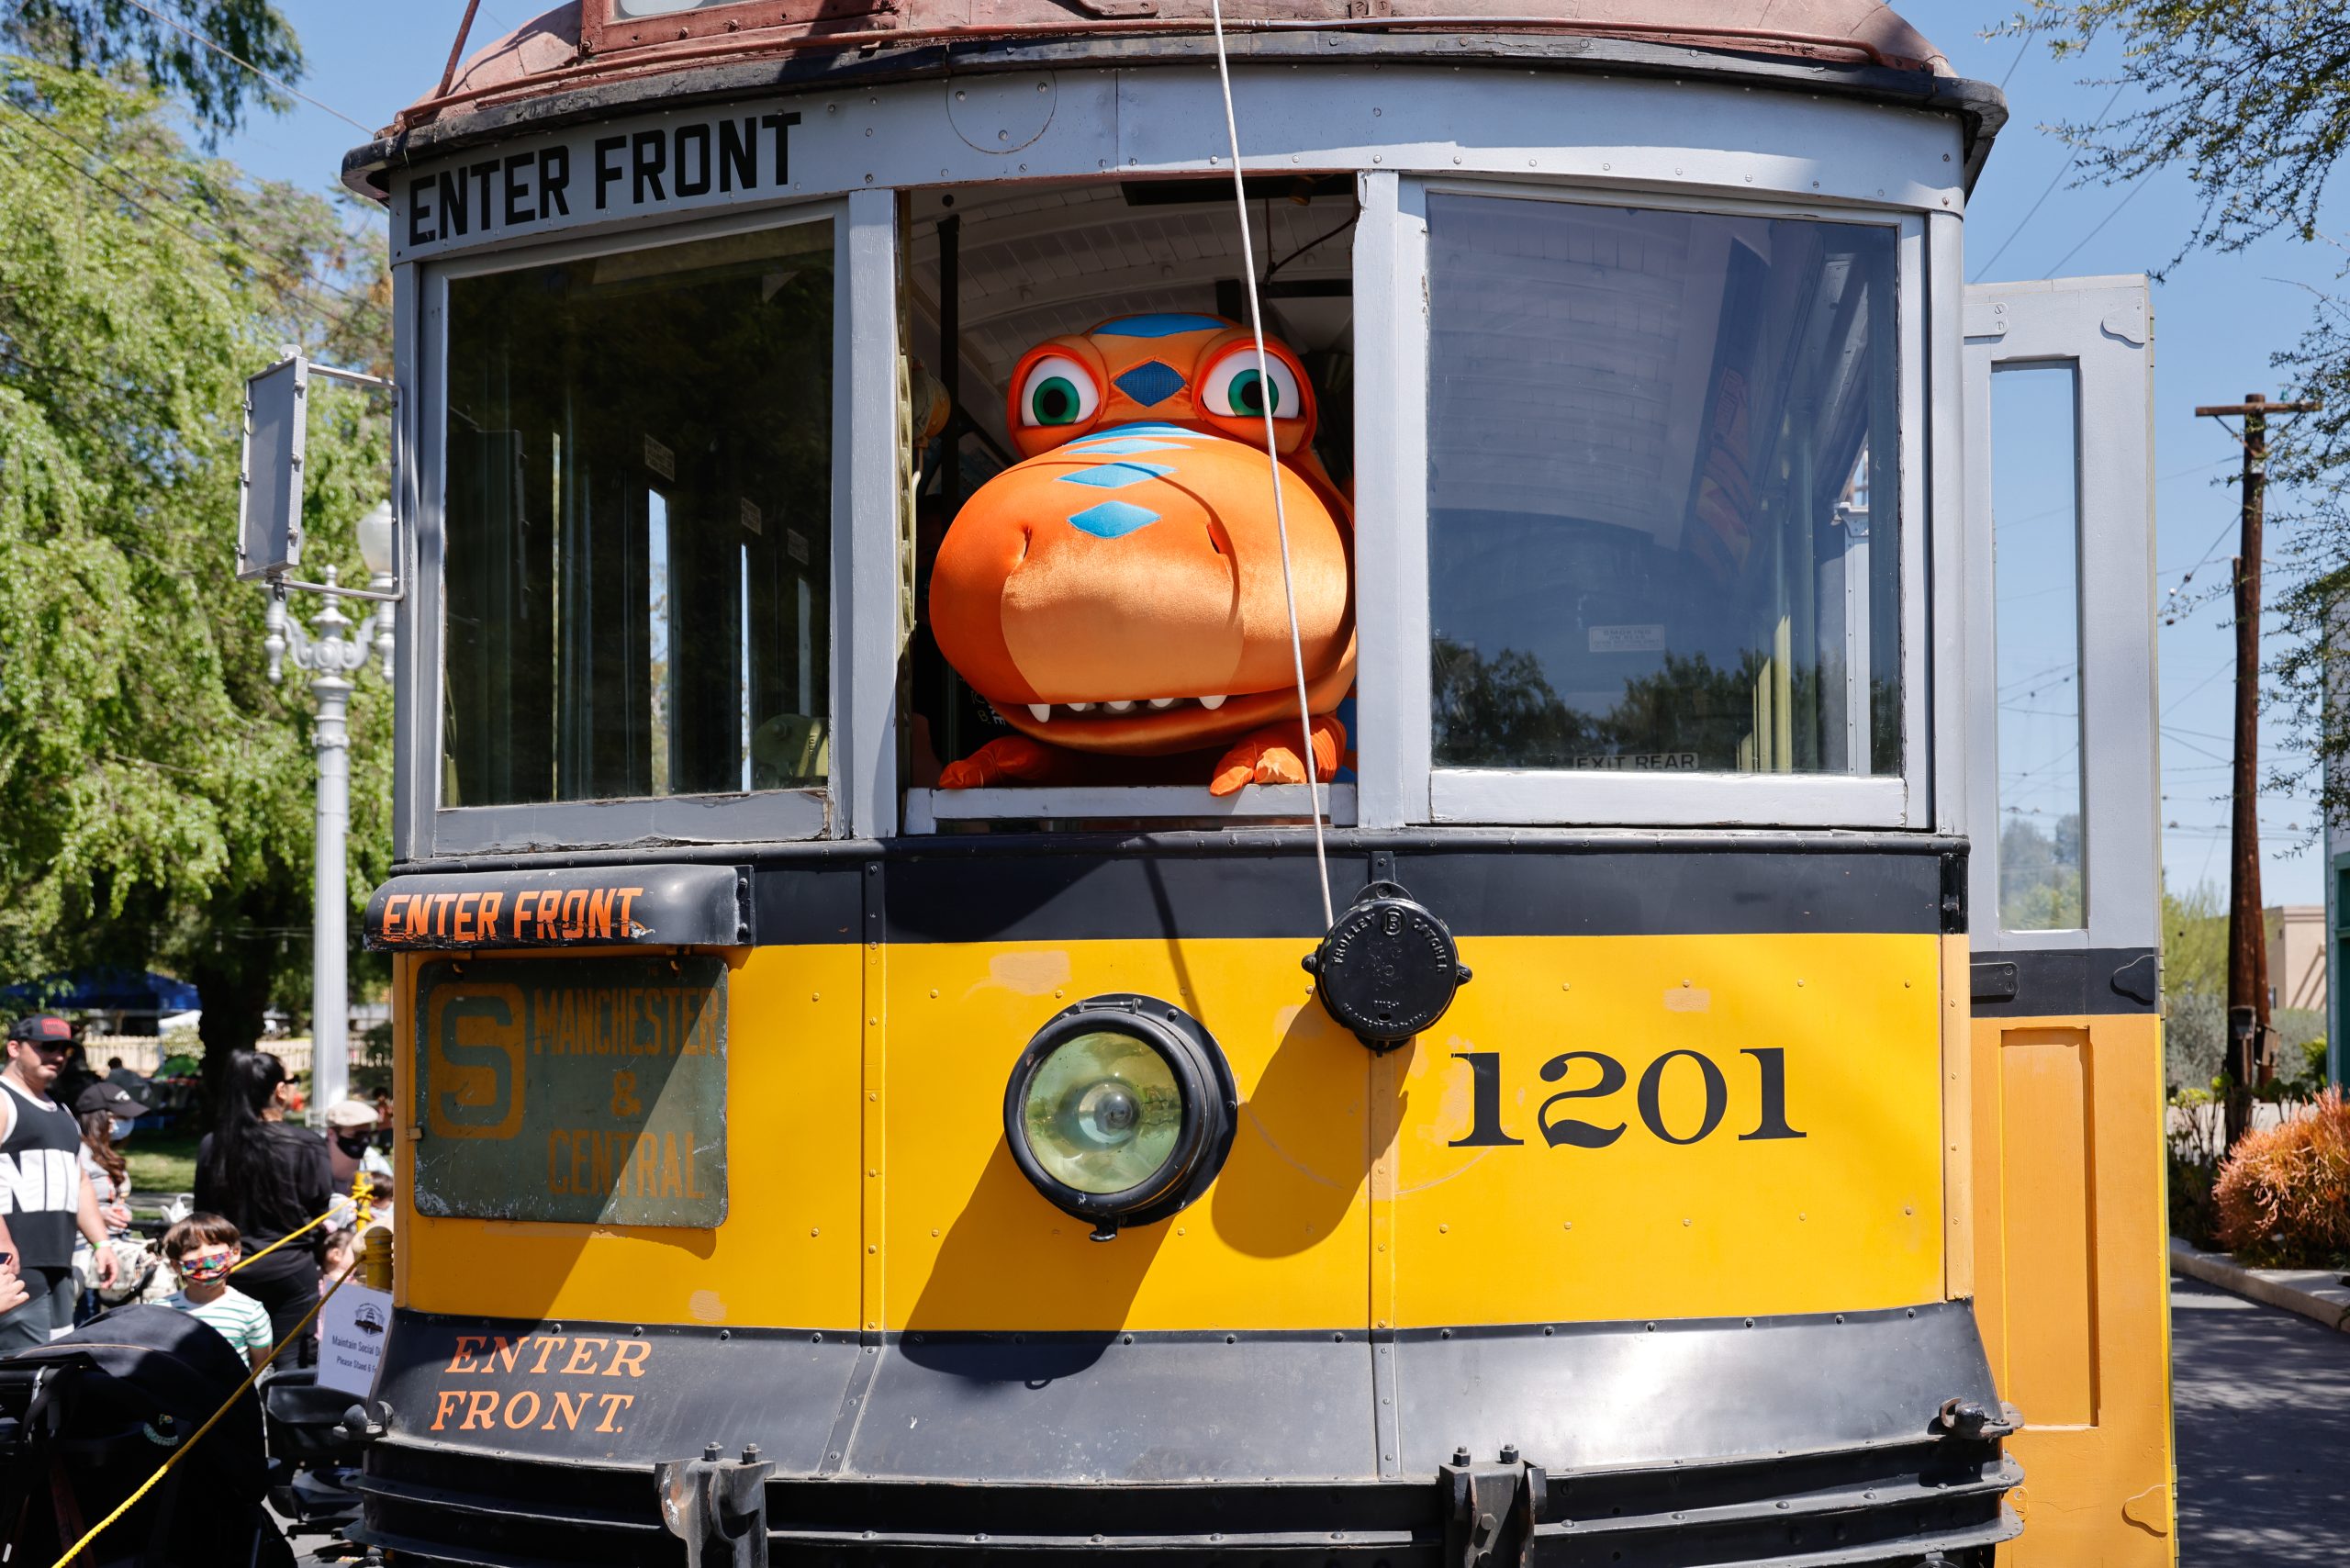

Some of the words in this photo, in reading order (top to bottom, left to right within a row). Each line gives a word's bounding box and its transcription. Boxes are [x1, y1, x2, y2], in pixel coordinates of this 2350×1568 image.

[409, 145, 569, 246] ENTER
[595, 112, 801, 209] FRONT
[1577, 756, 1626, 769] EXIT
[1635, 754, 1695, 769] REAR
[383, 890, 503, 942] ENTER
[513, 888, 643, 939] FRONT
[534, 987, 718, 1057] MANCHESTER
[430, 984, 525, 1139] S
[611, 1070, 641, 1116] &
[1449, 1047, 1807, 1148] 1201
[548, 1130, 705, 1199] CENTRAL
[332, 1334, 357, 1350] Maintain
[358, 1340, 375, 1355] Social
[337, 1355, 352, 1367] Please
[353, 1360, 366, 1372] Stand
[444, 1336, 652, 1377] ENTER
[430, 1391, 634, 1433] FRONT.
